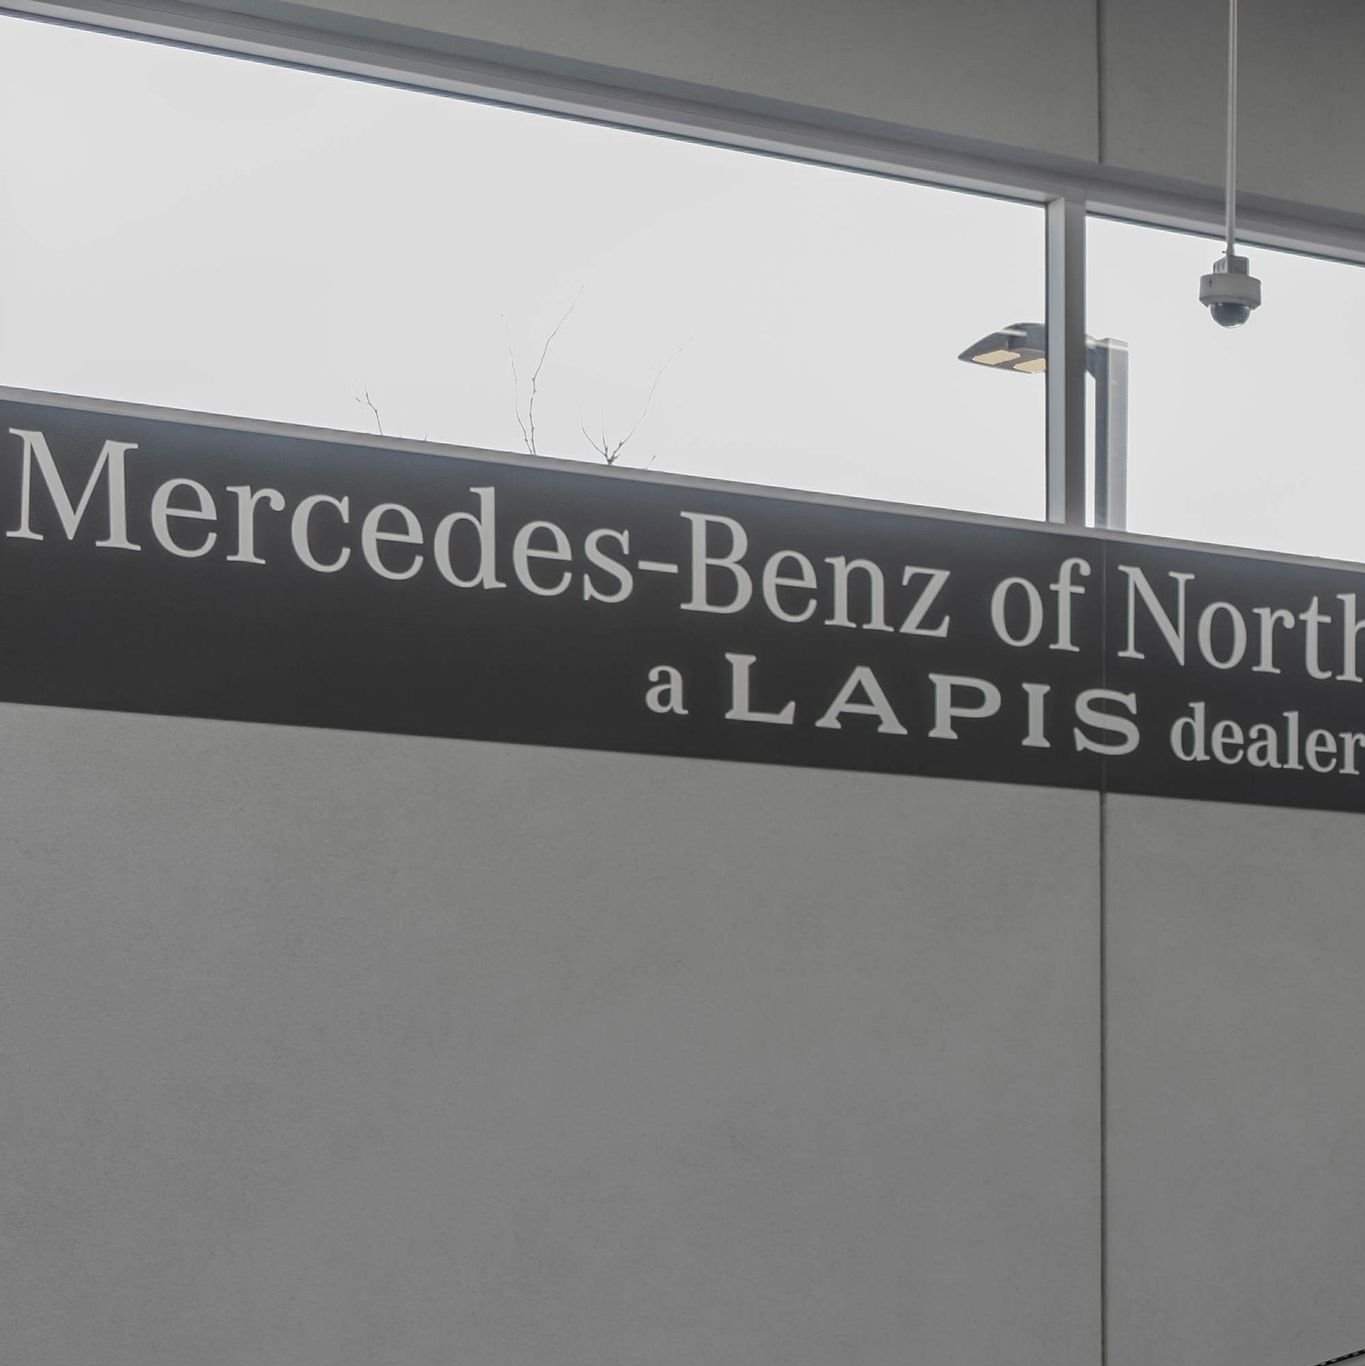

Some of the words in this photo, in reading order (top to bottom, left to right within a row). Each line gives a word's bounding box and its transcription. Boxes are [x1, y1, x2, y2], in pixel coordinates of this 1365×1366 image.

[6, 427, 951, 638] Mercedes-Benz
[991, 557, 1092, 652] of
[645, 665, 689, 715] a
[724, 652, 1140, 755] LAPIS
